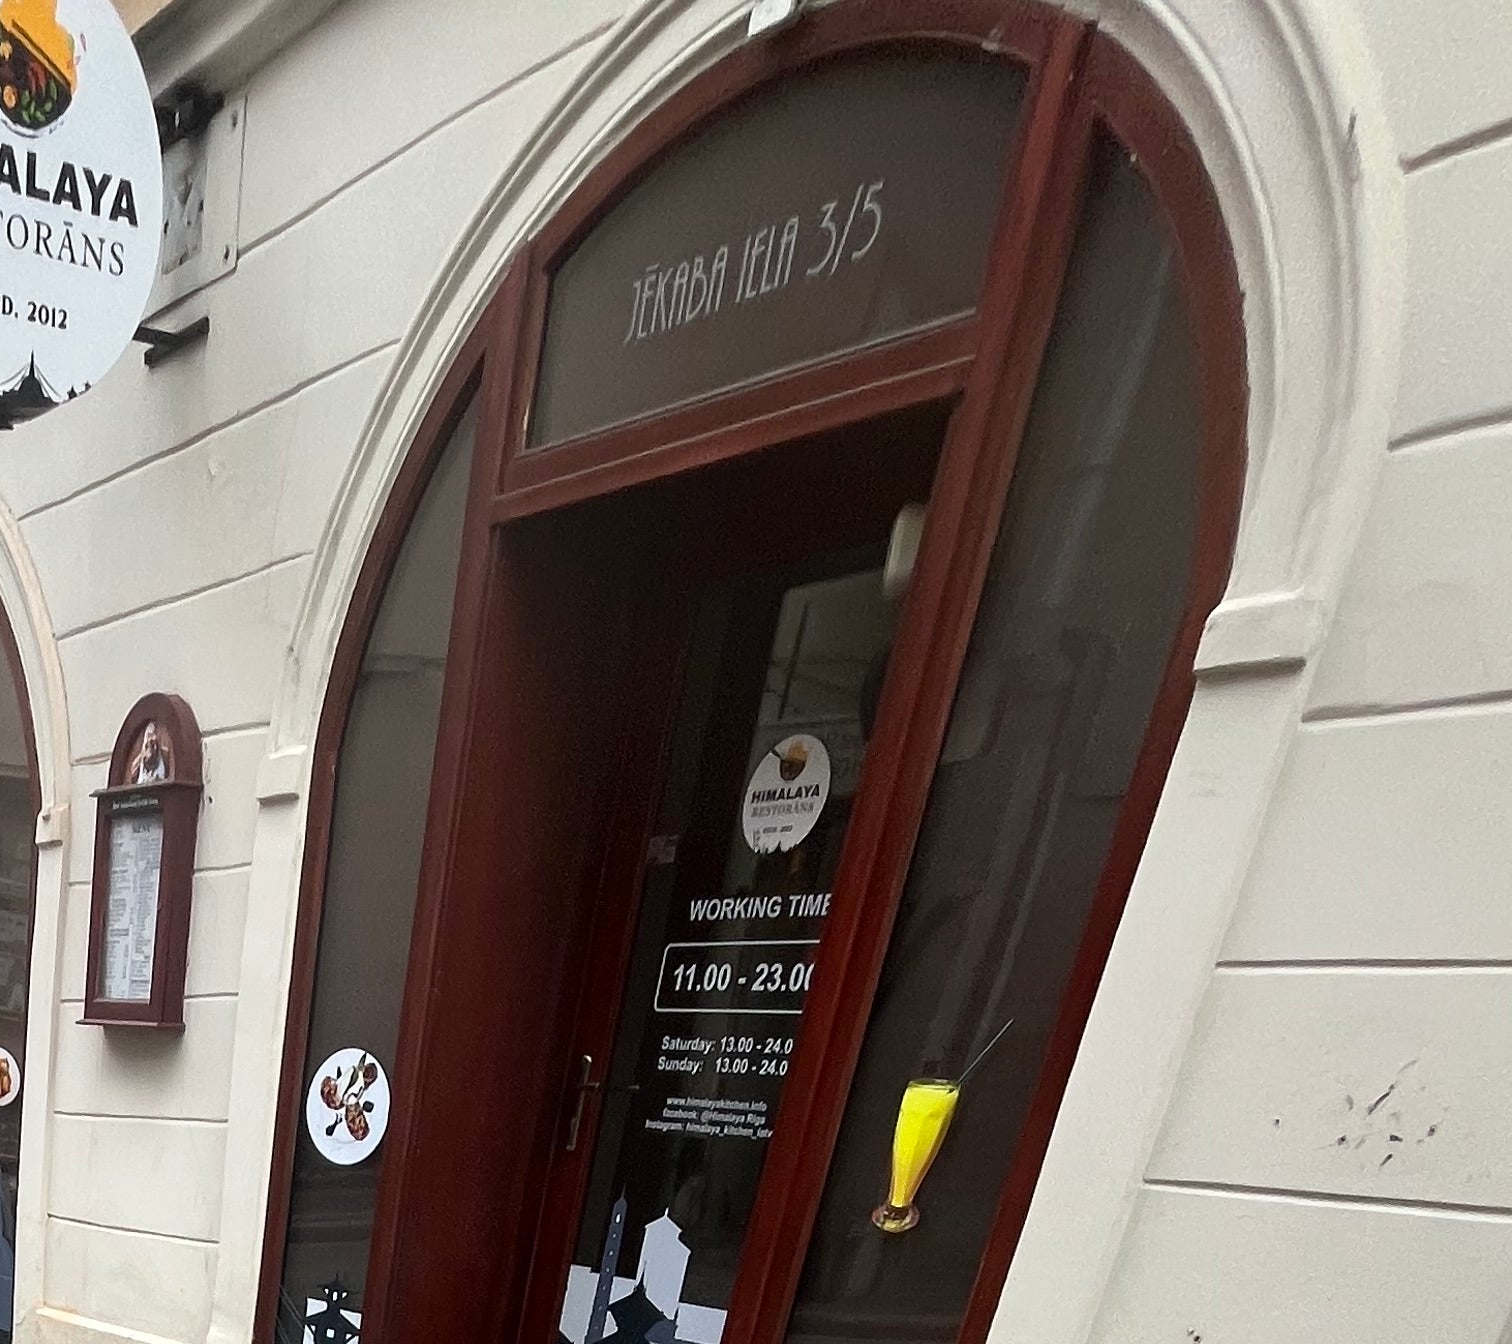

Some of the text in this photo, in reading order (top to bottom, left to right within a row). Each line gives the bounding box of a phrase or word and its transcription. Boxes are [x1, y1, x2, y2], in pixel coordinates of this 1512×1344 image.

[734, 214, 800, 303] IELA
[805, 181, 884, 279] 3/5
[27, 301, 68, 330] 2012
[751, 784, 820, 804] HIMALAYA
[690, 896, 782, 922] WORKING
[673, 963, 732, 992] 11.00
[661, 1035, 716, 1054] Saturday:
[720, 1036, 754, 1053] 13.00
[657, 1056, 704, 1075] Sunday:
[715, 1057, 748, 1074] 13.00
